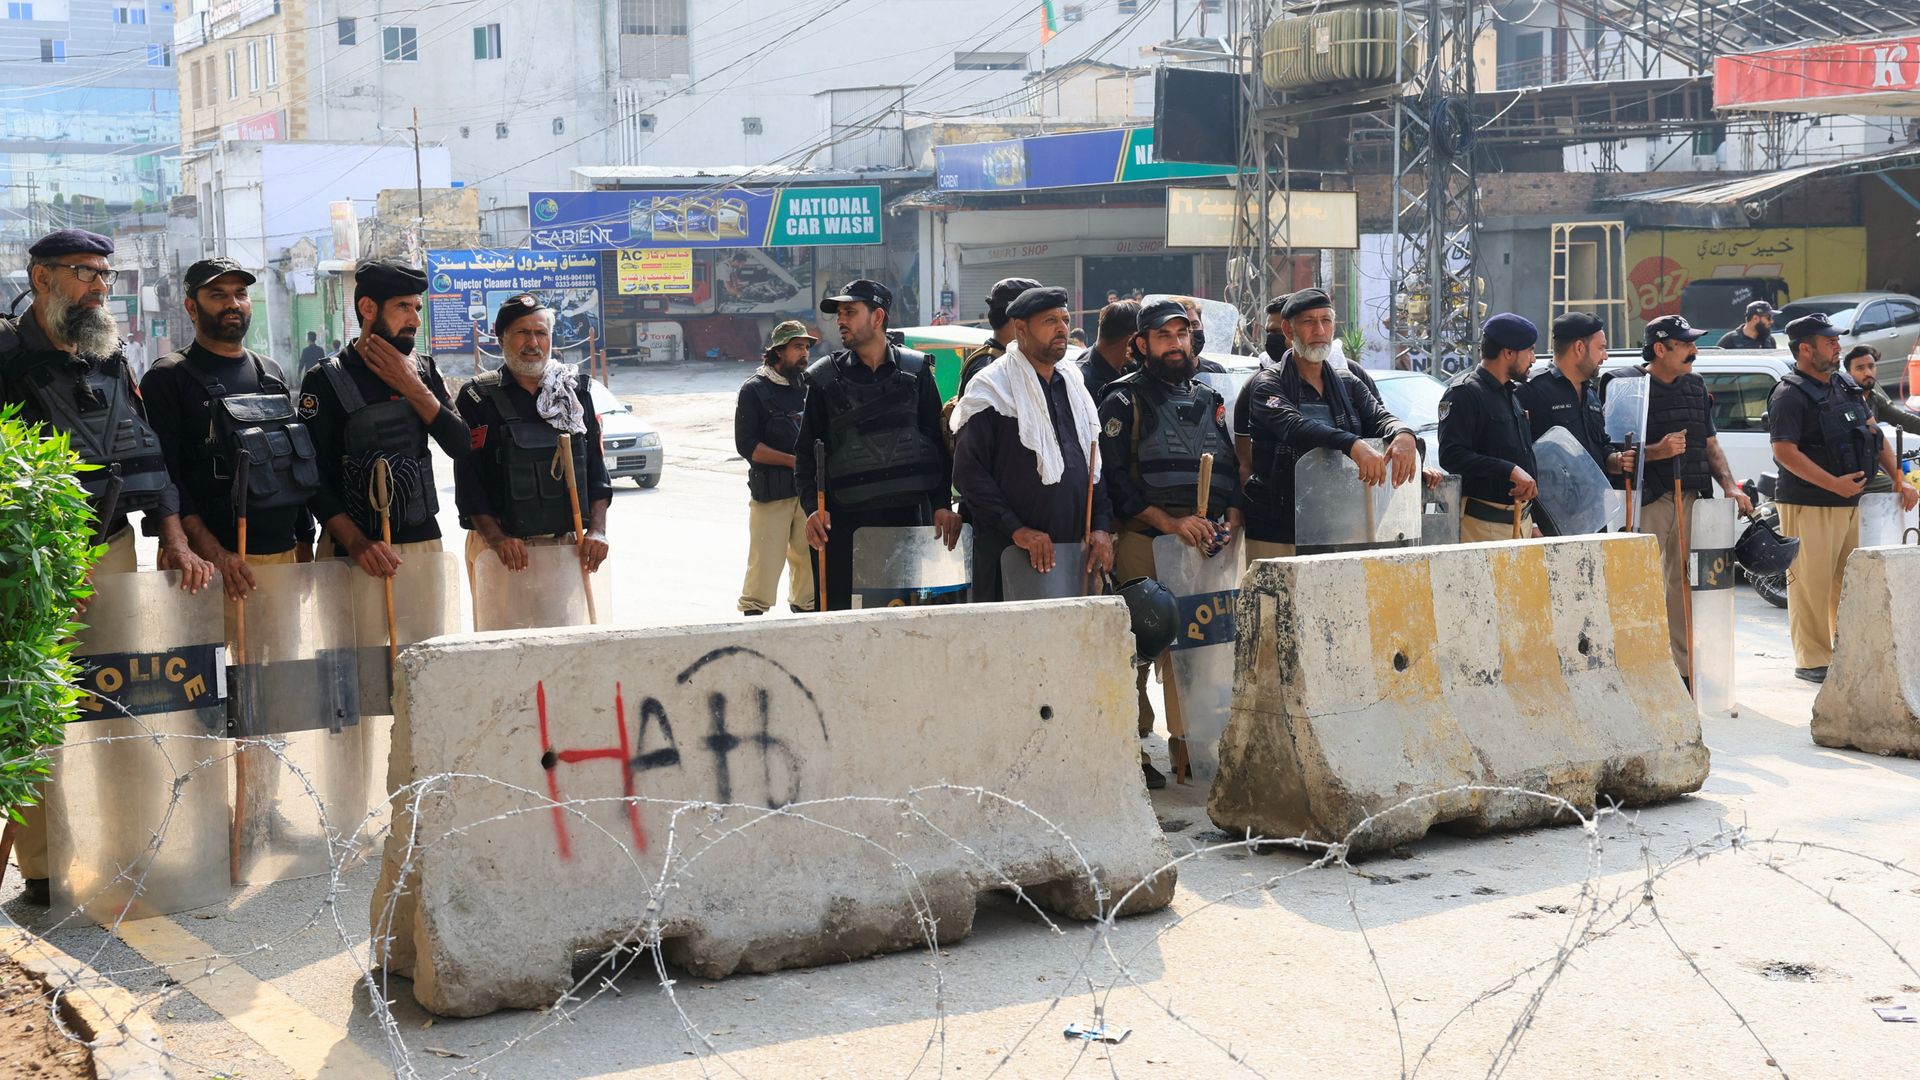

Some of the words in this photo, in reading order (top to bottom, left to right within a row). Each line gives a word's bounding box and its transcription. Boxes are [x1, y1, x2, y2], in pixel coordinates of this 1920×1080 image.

[788, 197, 871, 216] NATIONAL
[785, 218, 820, 236] CAR
[823, 216, 874, 234] WASH
[536, 229, 613, 246] CARIENT
[1117, 242, 1133, 253] OIL
[1138, 240, 1164, 252] SHOP
[620, 250, 643, 261] AC
[1022, 244, 1049, 257] SHOP
[454, 278, 482, 291] Injector
[483, 277, 512, 289] Cleaner
[512, 277, 518, 288] &
[519, 276, 542, 289] Tester
[1623, 268, 1690, 321] Jazz
[1187, 594, 1232, 641] POLI
[78, 656, 207, 713] POLICE
